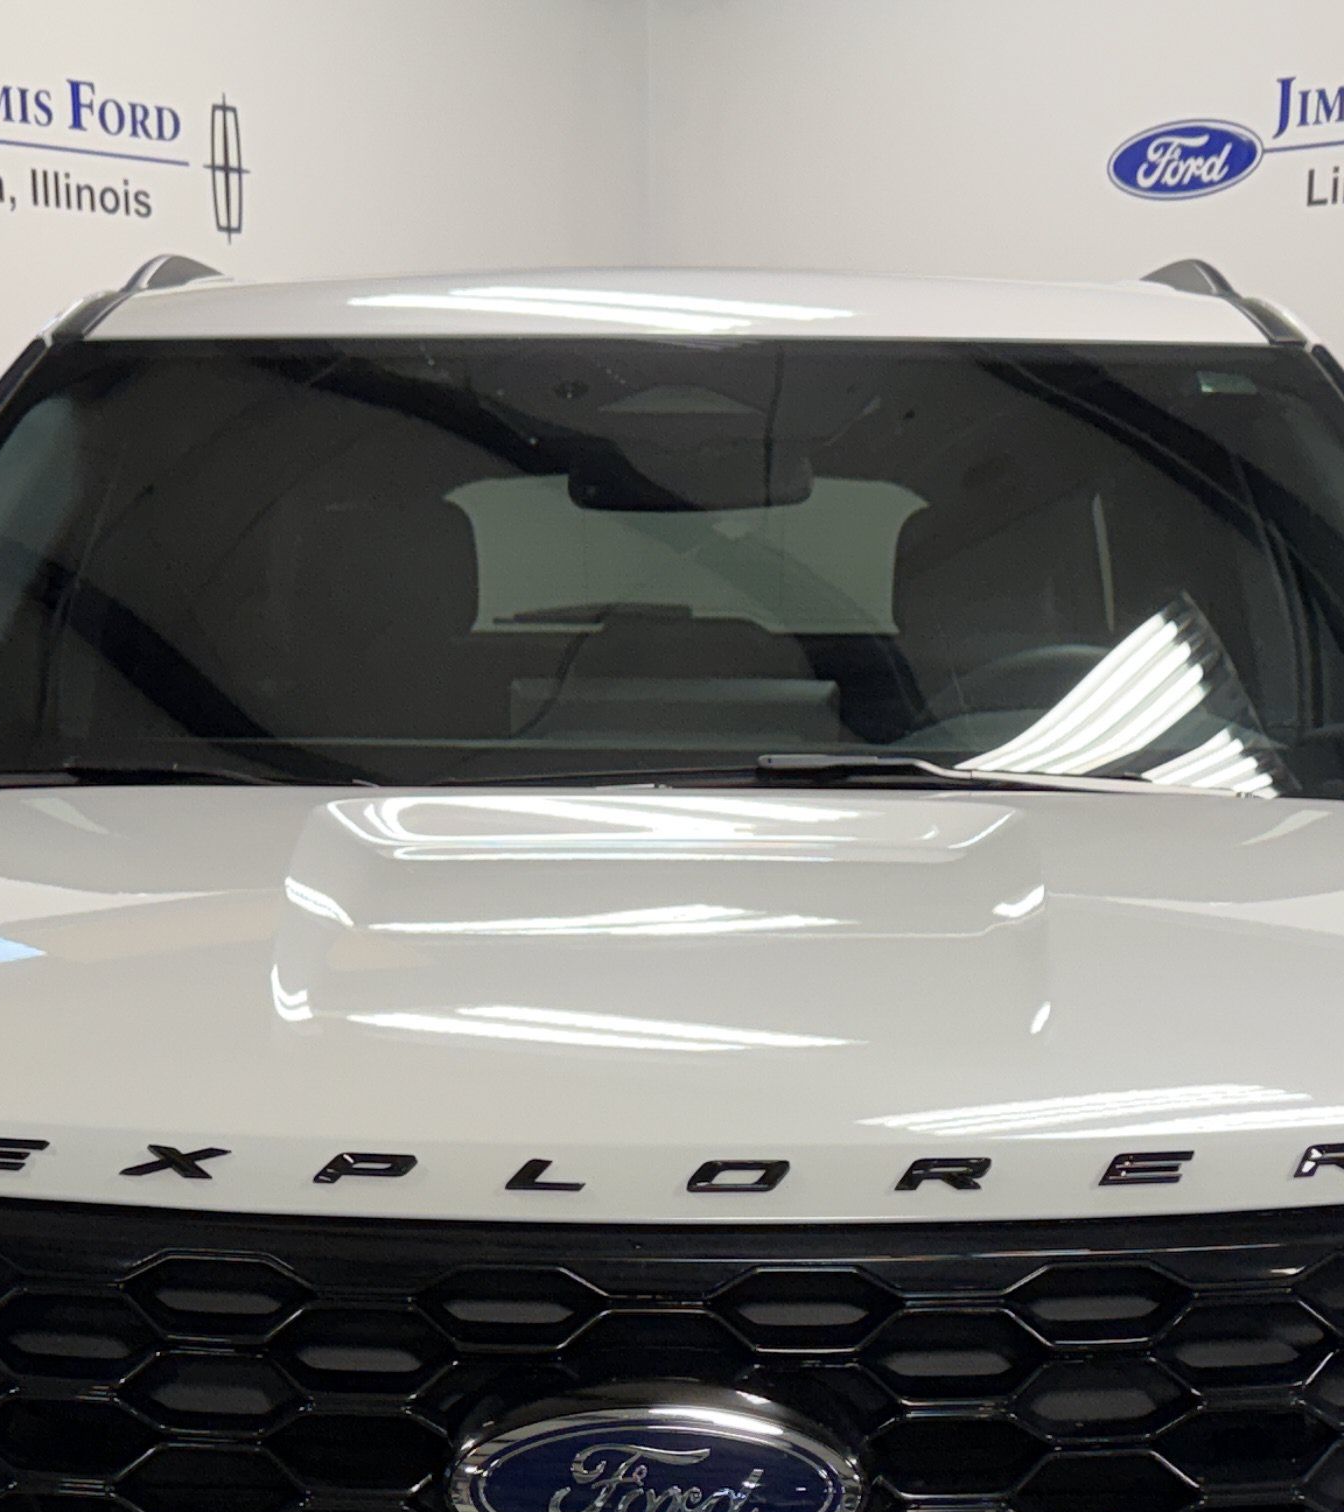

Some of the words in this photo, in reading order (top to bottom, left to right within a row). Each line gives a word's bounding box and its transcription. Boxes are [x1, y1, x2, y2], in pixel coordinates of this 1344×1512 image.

[66, 79, 181, 143] FORD
[1136, 134, 1229, 189] Ford
[31, 168, 153, 219] Illinois
